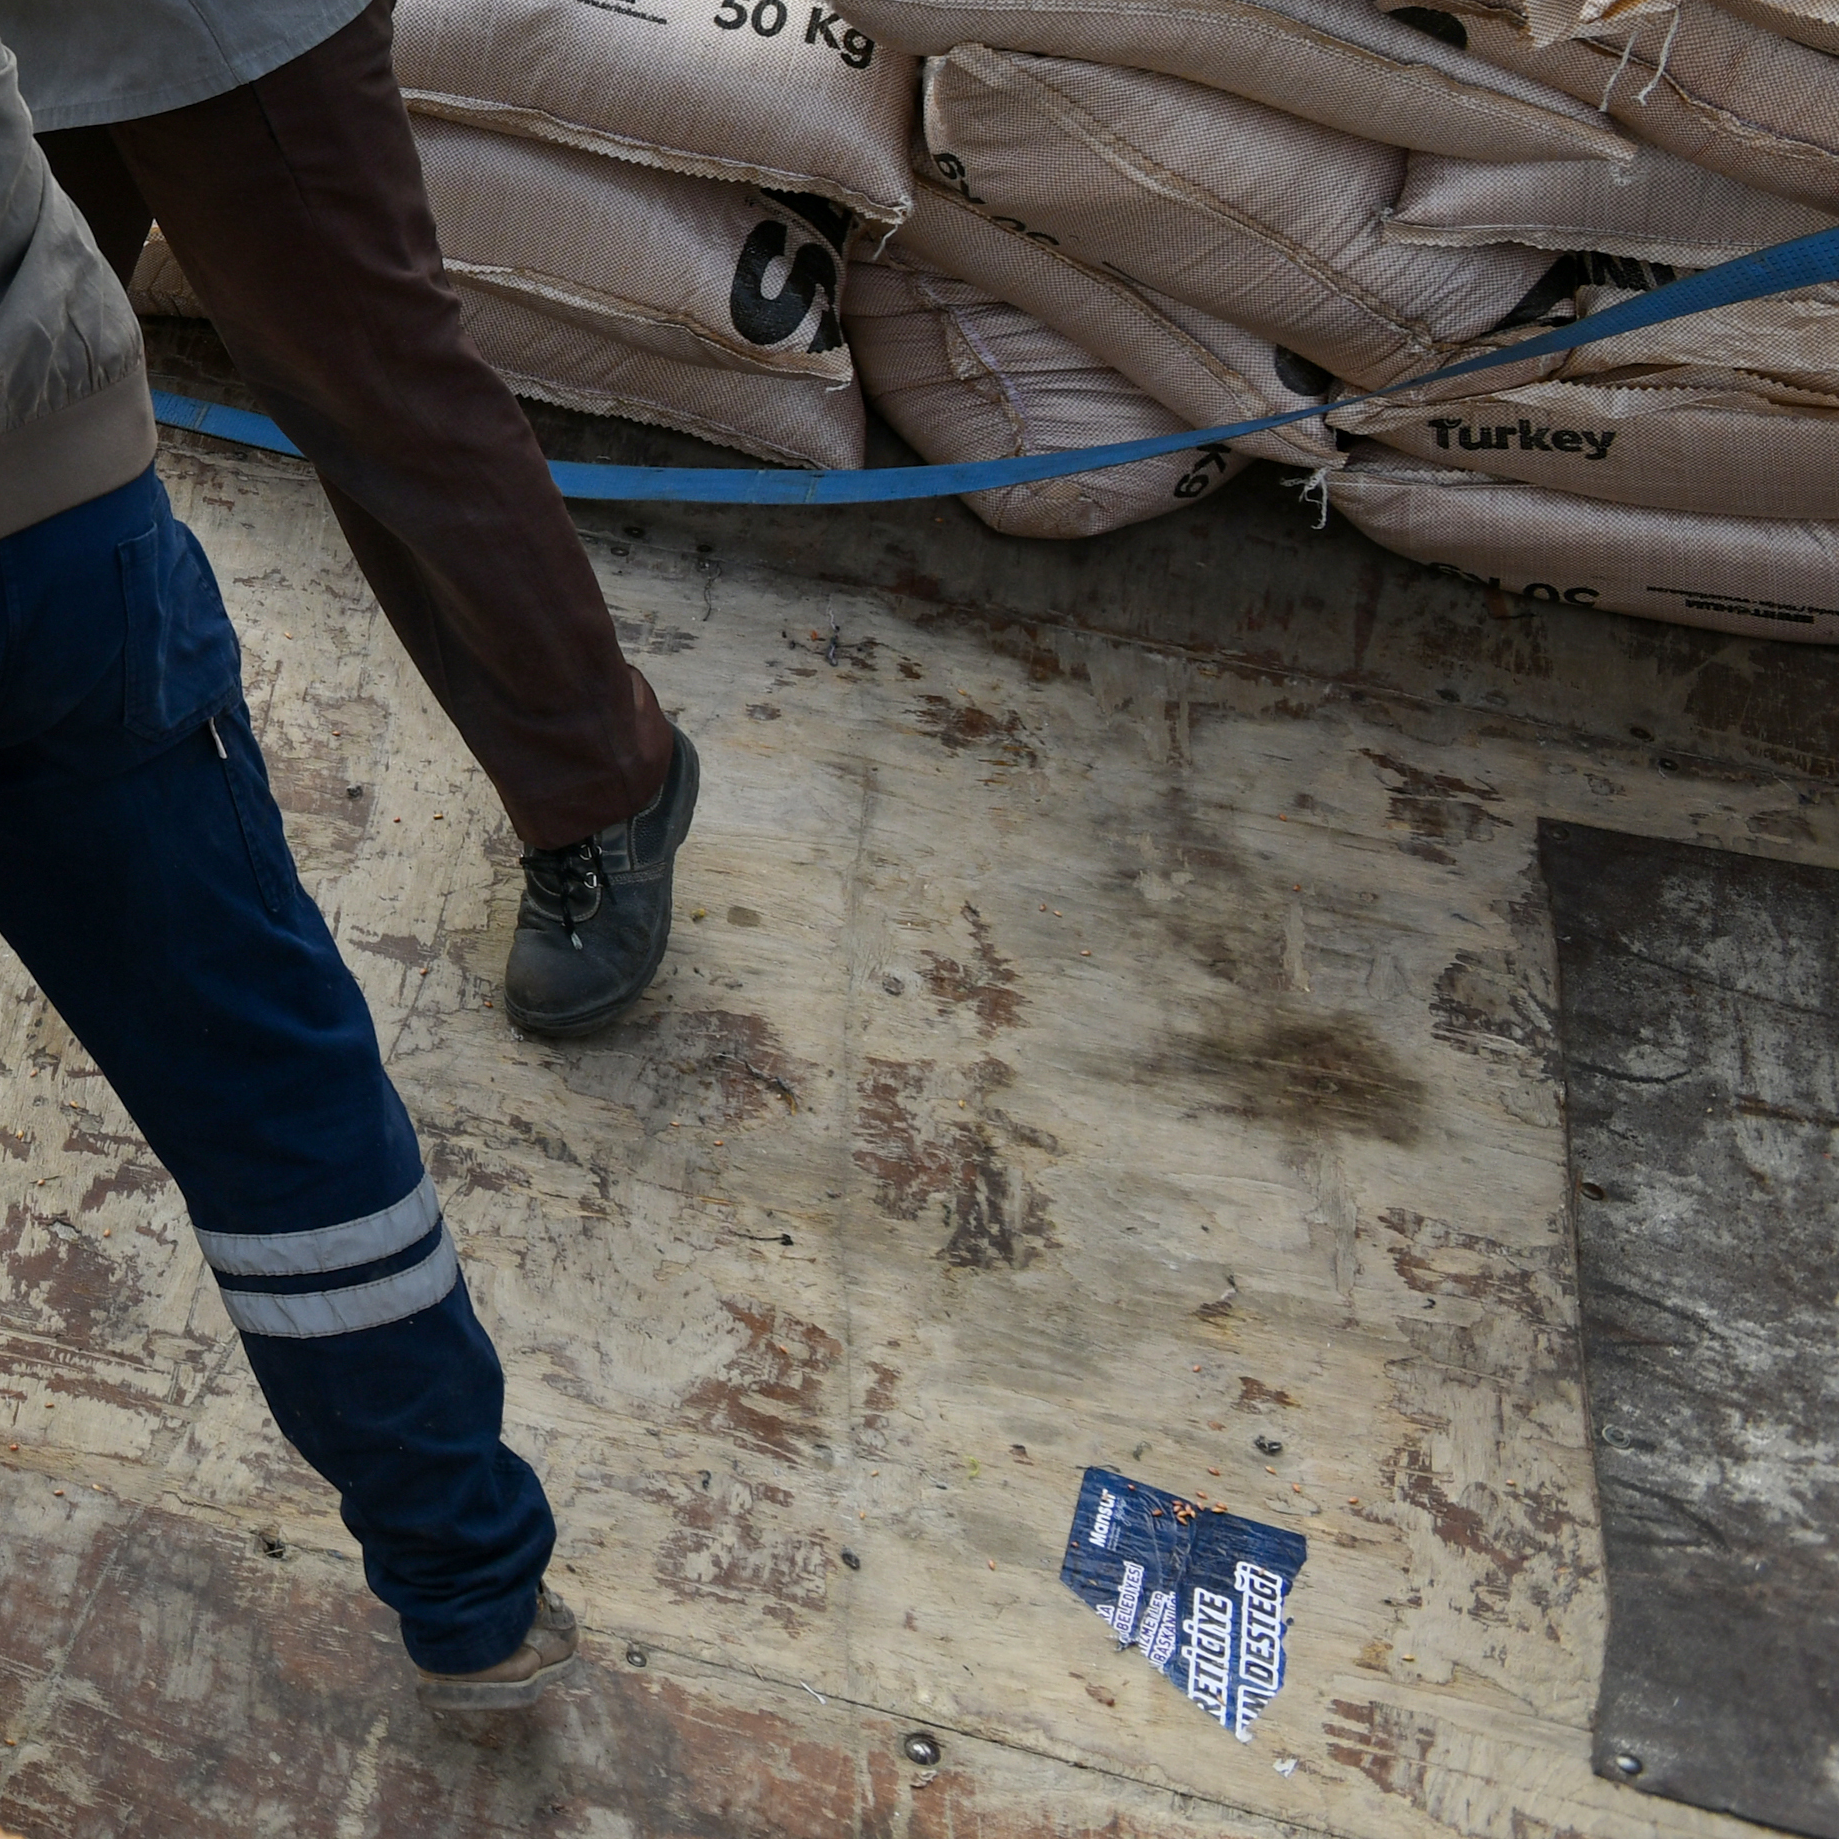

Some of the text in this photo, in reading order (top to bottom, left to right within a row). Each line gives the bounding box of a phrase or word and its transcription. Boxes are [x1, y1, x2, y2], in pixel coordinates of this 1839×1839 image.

[804, 5, 875, 70] Kg
[1427, 416, 1618, 460] Turkey
[1088, 1487, 1117, 1548] Mansur
[1115, 1561, 1145, 1633] BELEDİYESİ
[1235, 1562, 1283, 1690] DESTEĞİ
